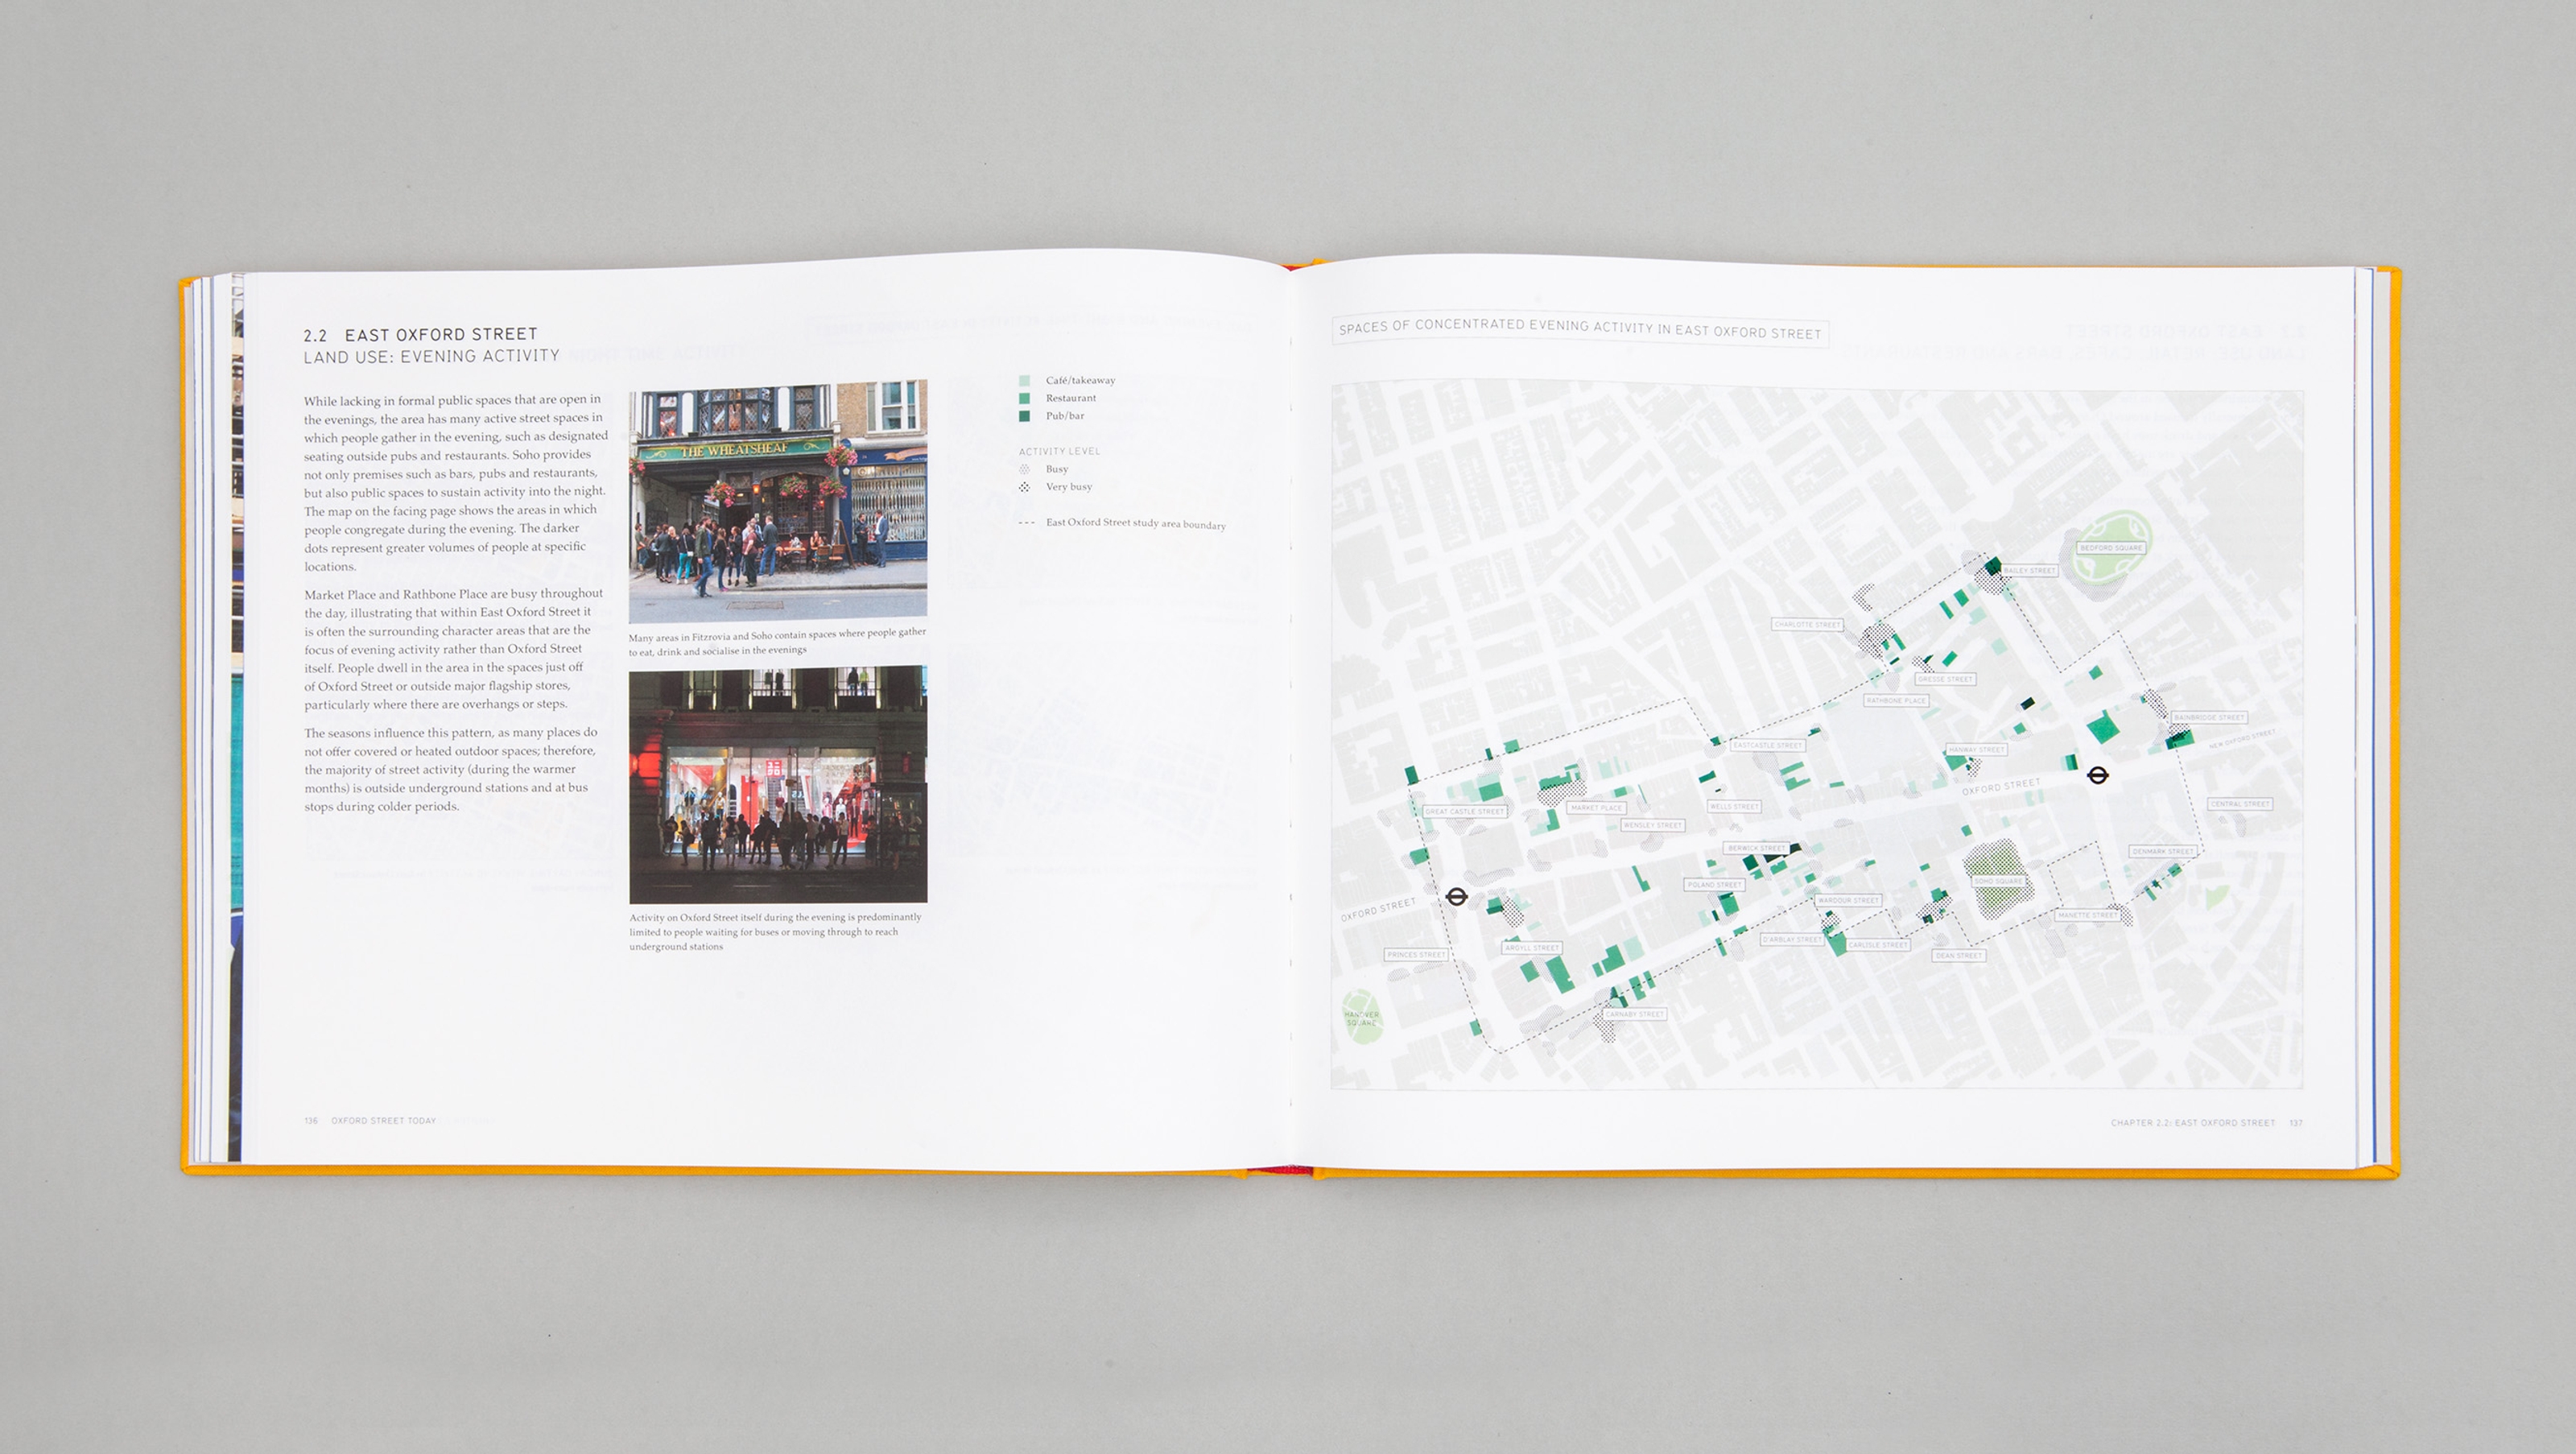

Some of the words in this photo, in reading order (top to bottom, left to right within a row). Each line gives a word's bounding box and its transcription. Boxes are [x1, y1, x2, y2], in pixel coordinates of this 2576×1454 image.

[303, 328, 327, 342] 2.2
[345, 328, 390, 342] EAST
[396, 328, 465, 341] OXFORD
[472, 327, 538, 341] STREET
[1339, 320, 1388, 336] SPACES
[1392, 320, 1410, 332] OF
[1414, 318, 1525, 330] CONCENTRATED
[1530, 319, 1589, 332] EVENING
[1593, 321, 1653, 333] ACTIVITY
[1657, 323, 1670, 334] IN
[1675, 324, 1709, 336] EAST
[1713, 325, 1766, 338] OXFORD
[1771, 327, 1821, 340] STREET
[303, 350, 349, 364] LAND
[355, 349, 394, 364] USE:
[401, 349, 476, 364] EVENING
[482, 348, 559, 362] ACTIVITY
[1046, 375, 1116, 386] Café/takeaway
[303, 395, 337, 407] While
[340, 395, 382, 409] lacking
[383, 395, 395, 406] in
[398, 395, 435, 406] formal
[438, 394, 473, 409] public
[475, 397, 512, 408] spaces
[514, 394, 536, 404] that
[539, 396, 557, 404] are
[559, 396, 587, 407] open
[590, 393, 601, 403] in
[1046, 394, 1096, 403] Restaurant
[303, 414, 322, 425] the
[324, 415, 378, 428] evenings,
[380, 413, 398, 424] the
[401, 416, 424, 424] area
[427, 413, 448, 423] has
[449, 415, 481, 427] many
[483, 413, 517, 423] active
[518, 414, 551, 423] street
[552, 415, 589, 426] spaces
[592, 411, 603, 422] in
[1046, 411, 1085, 420] Pub/bar
[682, 448, 704, 458] THE
[708, 444, 788, 456] WHEATSHEAF
[1018, 446, 1066, 456] ACTIVITY
[1068, 446, 1100, 456] LEVEL
[1046, 465, 1069, 476] Busy
[1046, 482, 1068, 494] Very
[1070, 481, 1093, 494] busy
[1046, 517, 1066, 527] East
[1067, 517, 1101, 527] Oxford
[1103, 517, 1130, 527] Street
[1133, 518, 1159, 530] study
[1183, 519, 1226, 533] boundary
[304, 589, 345, 601] Market
[347, 589, 377, 600] Place
[378, 589, 400, 600] and
[402, 589, 456, 600] Rathbone
[459, 589, 488, 599] Place
[490, 591, 509, 599] are
[510, 588, 538, 601] busy
[540, 587, 603, 601] throughout
[1773, 621, 1813, 629] CHARLOTTE
[1814, 621, 1840, 629] STREET
[628, 634, 654, 644] Many
[681, 634, 690, 642] in
[691, 633, 731, 642] Fitzrovia
[733, 631, 749, 641] and
[750, 630, 773, 640] Soho
[774, 630, 807, 639] contain
[808, 631, 837, 641] spaces
[838, 628, 865, 638] where
[867, 627, 897, 639] people
[898, 626, 927, 638] gather
[628, 649, 638, 657] to
[639, 649, 655, 657] eat,
[656, 647, 682, 656] drink
[683, 646, 700, 656] and
[702, 646, 740, 655] socialise
[741, 646, 750, 655] in
[752, 645, 766, 655] the
[768, 645, 807, 656] evenings
[2174, 713, 2217, 721] BAINBRIDGE
[2224, 734, 2251, 746] OXFORD
[2251, 728, 2276, 739] STREET
[1733, 741, 1776, 750] EASTCASTLE
[1776, 741, 1802, 750] STREET
[1948, 746, 1977, 754] HANWAY
[1979, 746, 2004, 754] STREET
[1961, 783, 2001, 796] OXFORD
[2003, 777, 2040, 790] STREET
[1477, 808, 1505, 816] STREET
[1623, 821, 1655, 829] WENSLEY
[1657, 821, 1682, 829] STREET
[1687, 881, 1715, 889] POLAND
[1716, 881, 1742, 889] STREET
[1340, 907, 1377, 923] OXFORD
[1379, 897, 1415, 913] STREET
[1796, 936, 1823, 944] STREET
[1344, 1010, 1379, 1018] HANOVER
[304, 1116, 318, 1125] 136
[331, 1116, 368, 1125] OXFORD
[370, 1116, 404, 1125] STREET
[407, 1116, 436, 1125] TODAY
[2111, 1118, 2153, 1127] CHAPTER
[2156, 1118, 2172, 1127] 2.2:
[2174, 1118, 2198, 1127] EAST
[2200, 1118, 2238, 1127] OXFORD
[2240, 1118, 2276, 1127] STREET
[2289, 1118, 2303, 1127] 137
